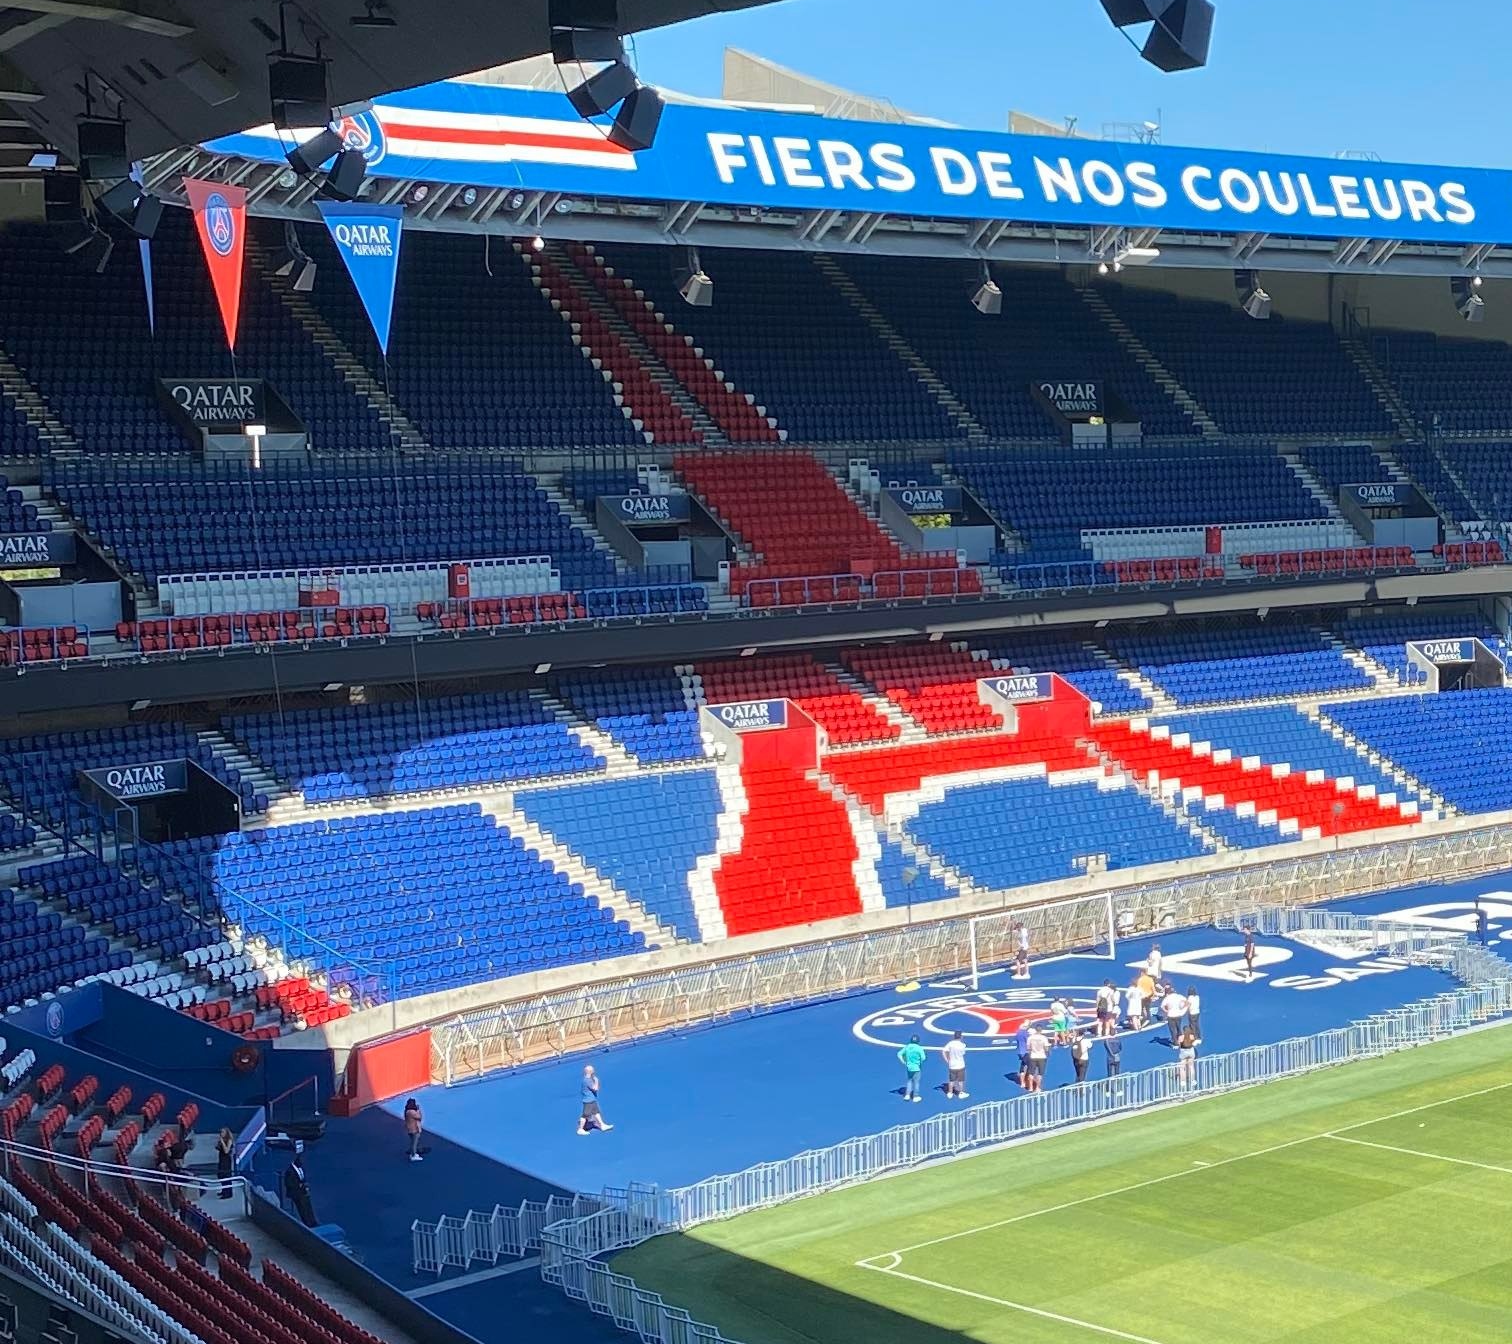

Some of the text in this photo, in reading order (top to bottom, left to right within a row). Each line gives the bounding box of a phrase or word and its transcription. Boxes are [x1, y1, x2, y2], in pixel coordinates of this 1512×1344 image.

[706, 132, 1476, 224] FIERS DE NOS COULEURS
[335, 224, 391, 247] QATAR
[353, 244, 393, 256] AIRWAYS
[171, 385, 255, 411] QATAR
[193, 407, 256, 420] AIRWAYS
[902, 489, 943, 505] QATAR
[1358, 485, 1394, 499] QATAR
[621, 497, 669, 513] QATAR
[4, 551, 50, 564] AIRWAYS
[1423, 642, 1460, 657] QATAR
[996, 677, 1038, 695] QATAR
[720, 703, 769, 722] QATAR
[107, 765, 165, 788] QATAR
[122, 780, 166, 795] AIRWAYS
[873, 989, 1047, 1027] PARIS
